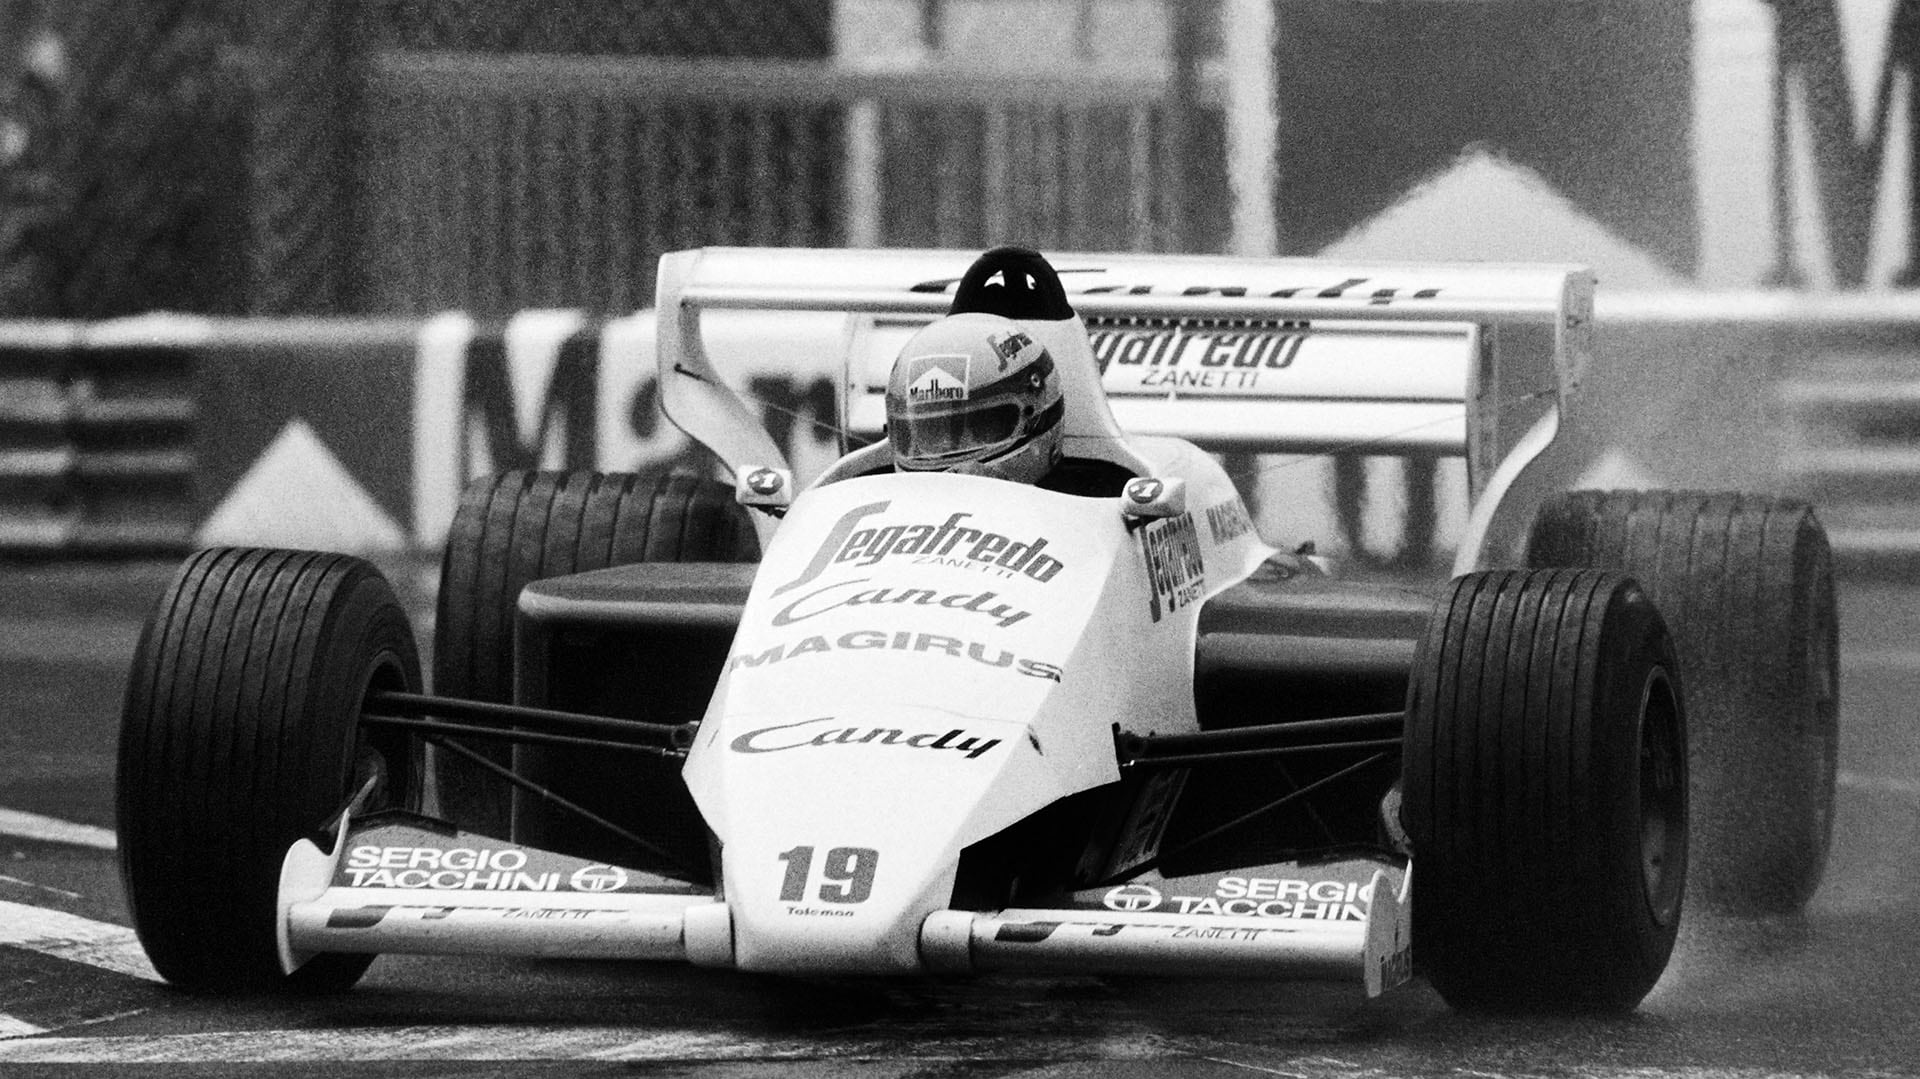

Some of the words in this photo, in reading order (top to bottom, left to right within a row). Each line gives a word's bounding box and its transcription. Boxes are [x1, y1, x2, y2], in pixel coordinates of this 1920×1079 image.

[909, 378, 964, 400] Marlboro
[1140, 369, 1260, 389] ZANETTI
[769, 499, 1064, 598] Segafredo
[911, 555, 1014, 579] ZANETTI
[771, 577, 1032, 627] Candy
[730, 630, 1064, 683] MAGIRUS
[730, 716, 1002, 759] Candy
[348, 845, 528, 871] SERGIO
[344, 868, 559, 892] TACCHINI
[778, 846, 880, 904] 19
[787, 906, 855, 917] Toleman
[1171, 896, 1367, 921] TACCHIN
